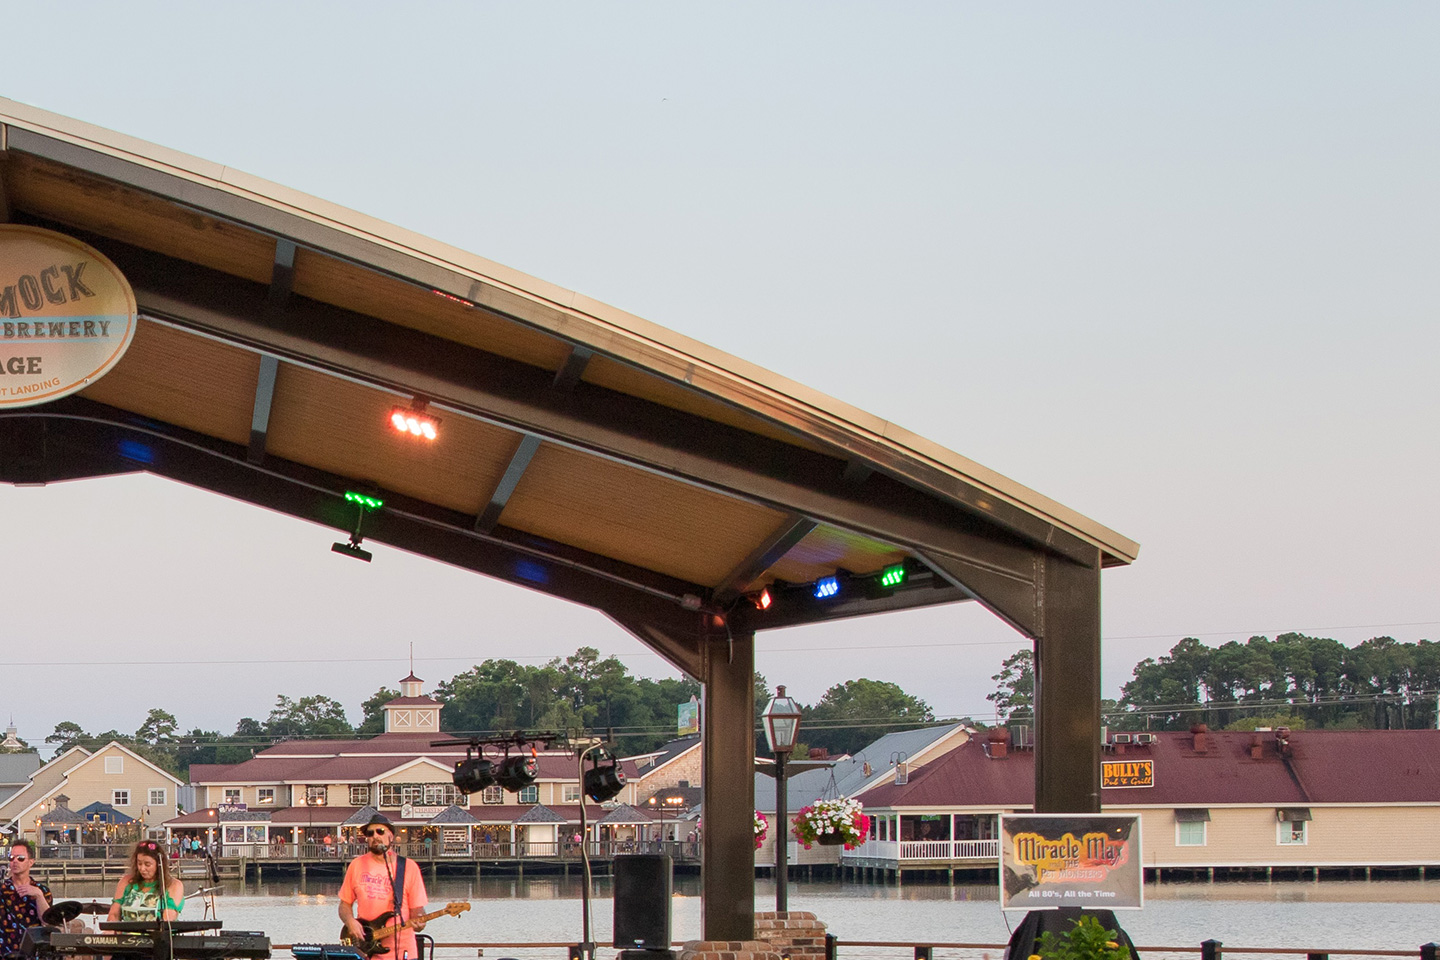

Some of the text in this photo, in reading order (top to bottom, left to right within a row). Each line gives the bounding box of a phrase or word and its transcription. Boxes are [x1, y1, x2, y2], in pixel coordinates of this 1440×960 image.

[3, 320, 111, 339] BREWERY
[10, 377, 60, 396] LANDING
[1104, 762, 1152, 778] BULLY'S
[1104, 778, 1118, 786] Pub
[1130, 777, 1152, 785] Grill
[1018, 836, 1125, 866] Miracle Max
[92, 937, 118, 945] YAMAHA
